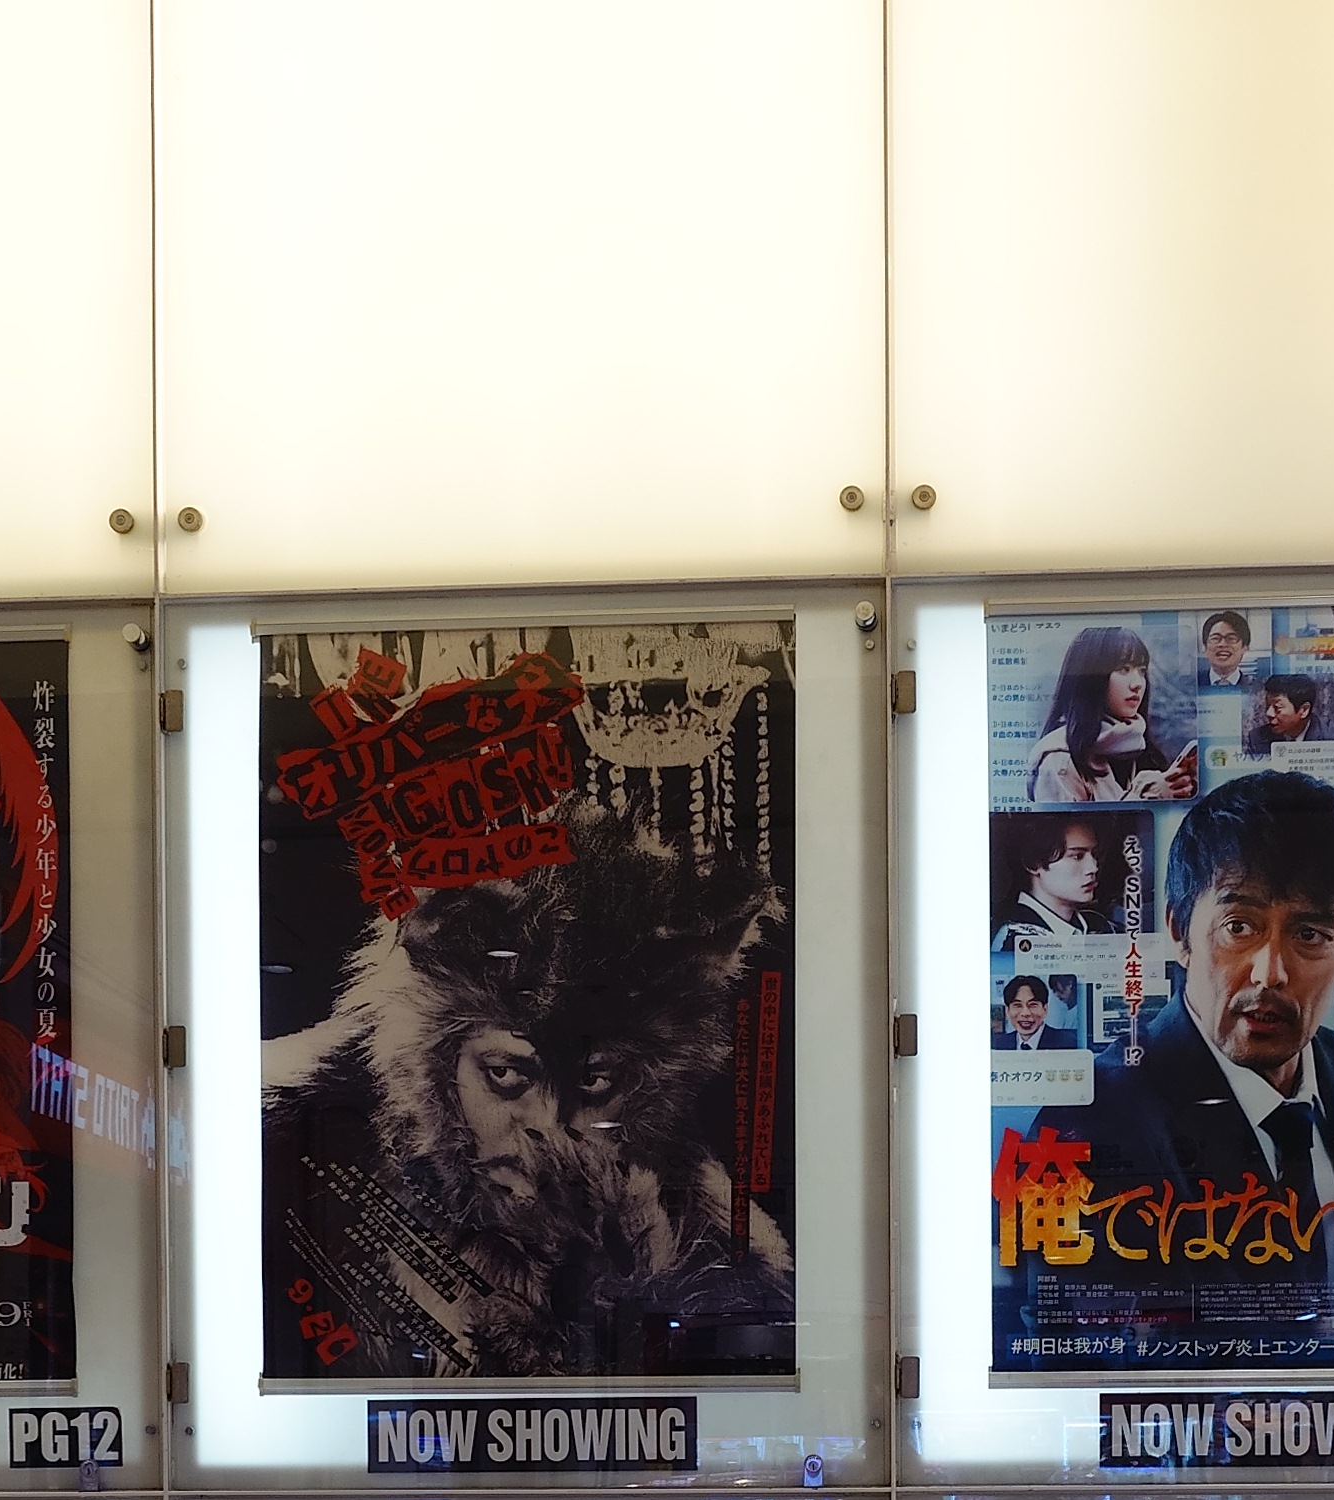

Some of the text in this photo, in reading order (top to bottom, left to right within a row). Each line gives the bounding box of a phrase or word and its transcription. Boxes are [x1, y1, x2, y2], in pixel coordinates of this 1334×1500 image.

[32, 679, 58, 1039] 炸裂する少年と少女の夏
[1011, 1335, 1127, 1357] #明日は我が身
[12, 1410, 121, 1463] PG12
[376, 1406, 687, 1464] NOW SHOWING
[1111, 1402, 1215, 1457] NOW
